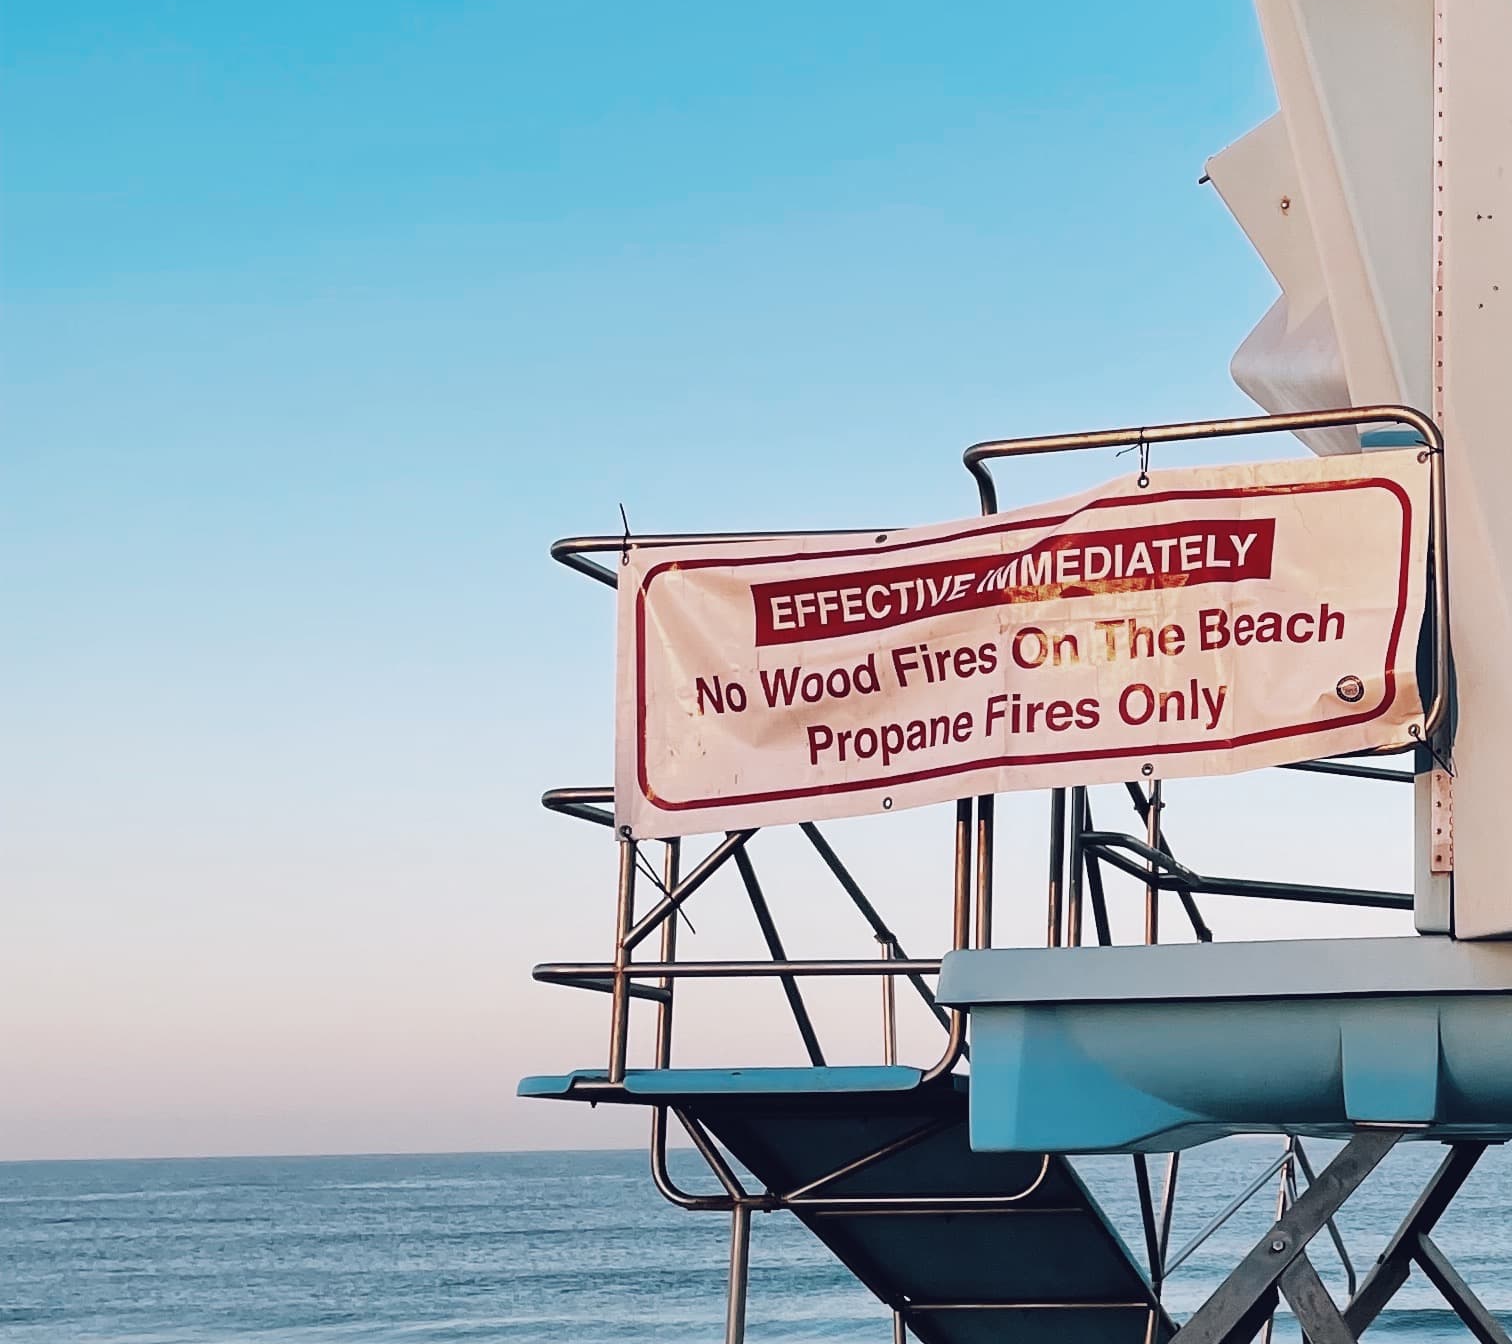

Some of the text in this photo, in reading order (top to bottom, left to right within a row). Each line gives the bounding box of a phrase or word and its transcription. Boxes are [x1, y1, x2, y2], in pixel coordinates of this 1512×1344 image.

[770, 533, 1258, 631] EFFECTIVE IMMEDIATELY
[695, 603, 1345, 716] No Wood Fires On The Beach
[807, 678, 1228, 766] Propane Fires Only
